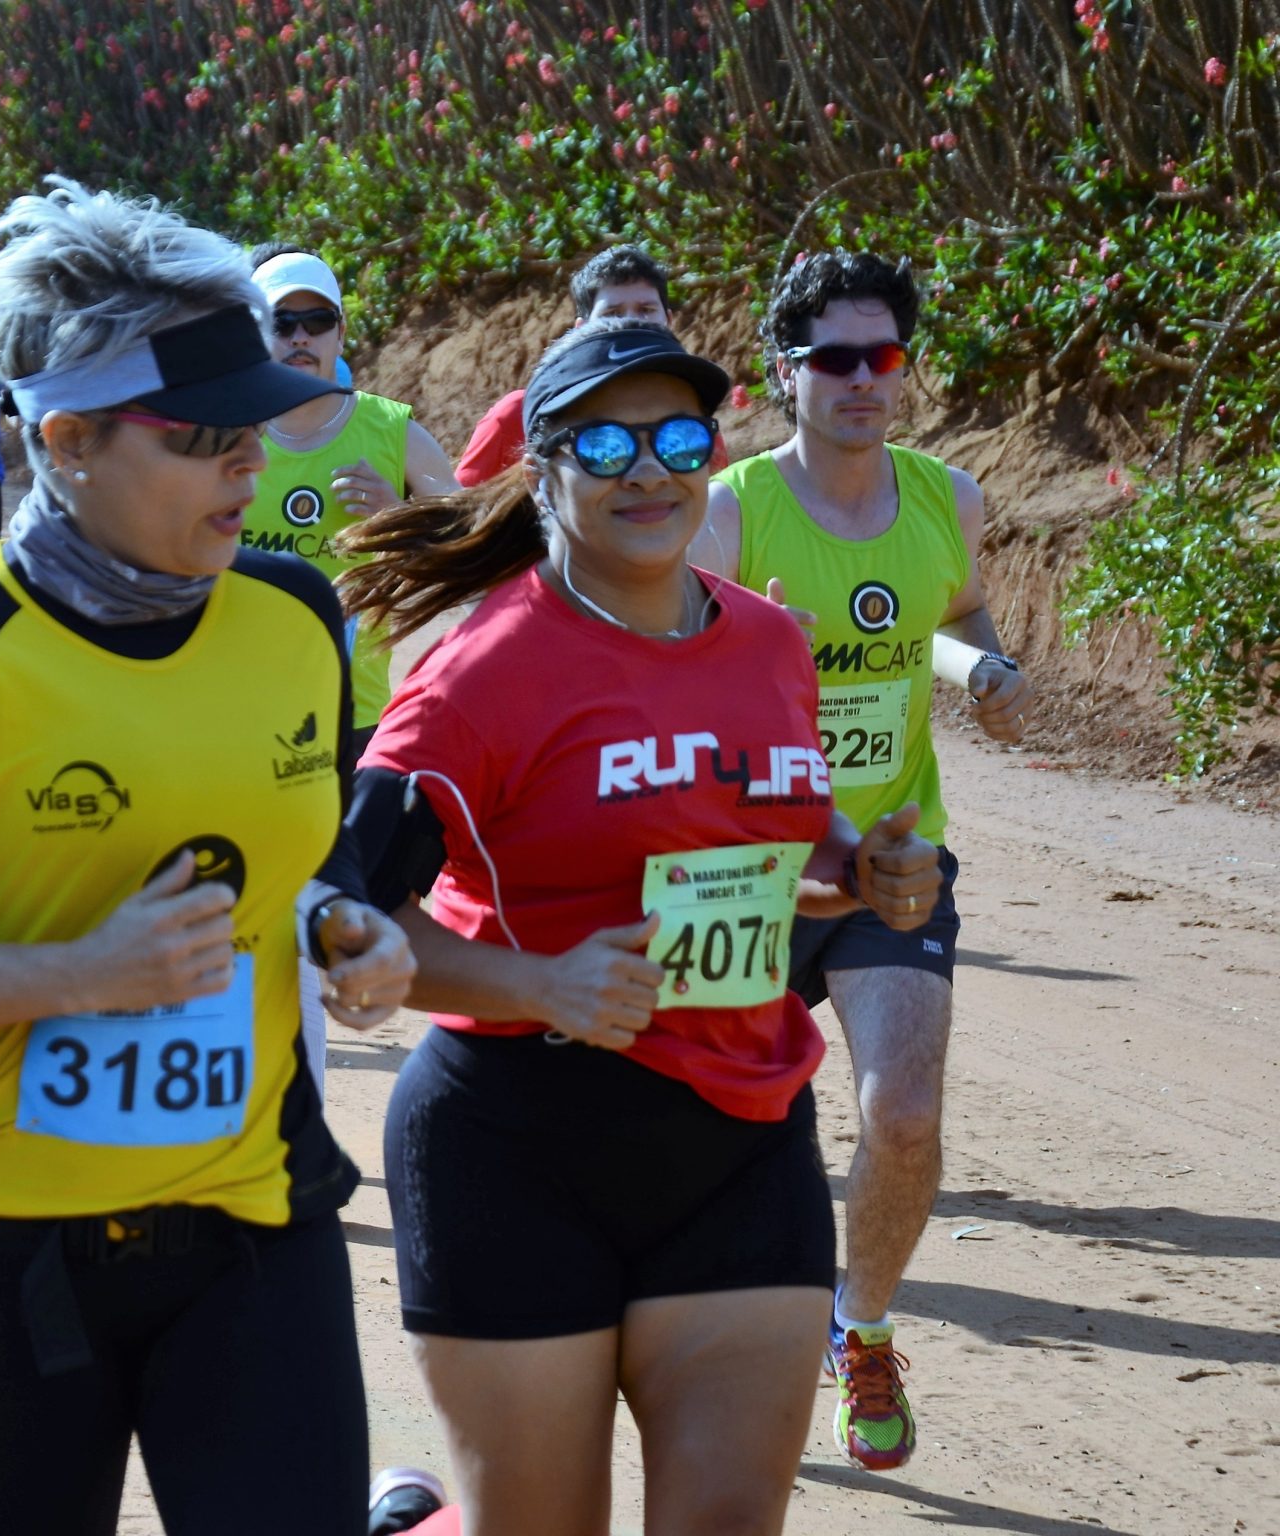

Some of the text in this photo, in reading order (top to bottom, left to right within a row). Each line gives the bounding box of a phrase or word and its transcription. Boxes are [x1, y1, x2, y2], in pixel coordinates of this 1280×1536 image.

[843, 708, 861, 716] 2017
[818, 728, 893, 769] 222
[41, 1035, 244, 1112] 3181
